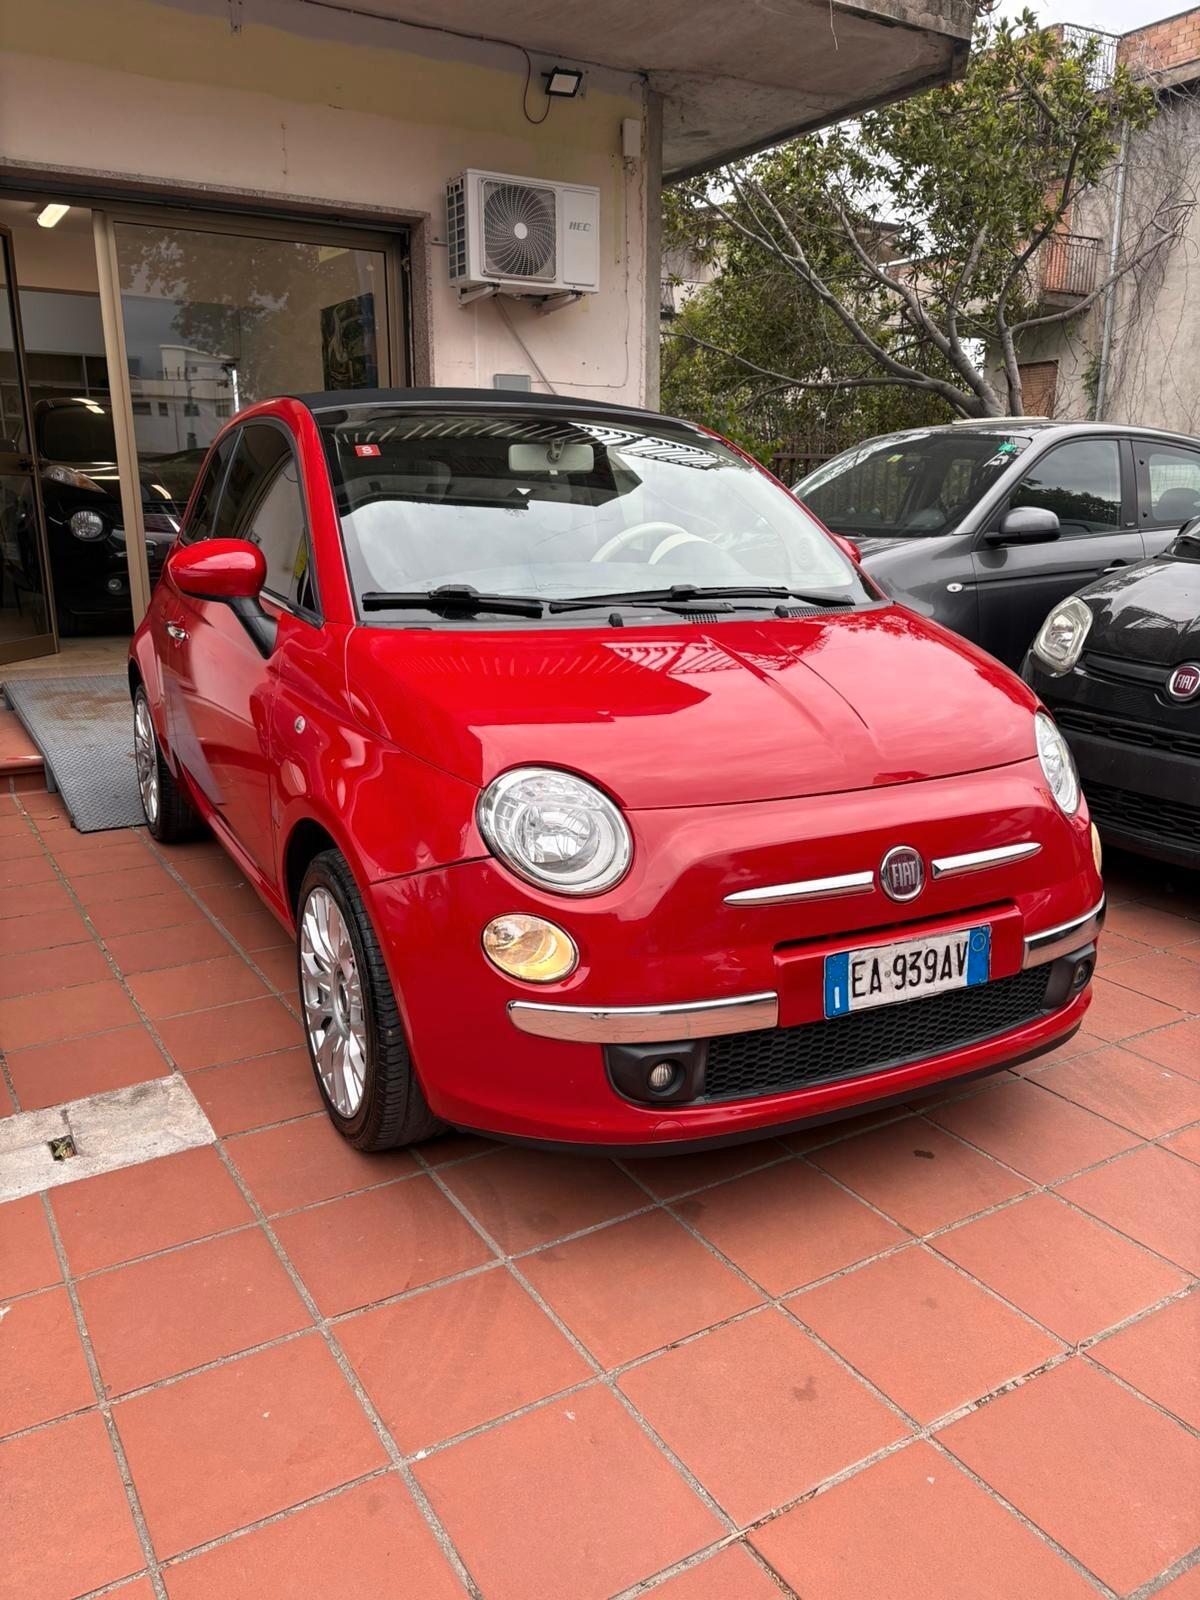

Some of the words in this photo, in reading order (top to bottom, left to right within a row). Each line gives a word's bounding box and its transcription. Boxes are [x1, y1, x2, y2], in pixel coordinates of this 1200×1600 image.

[1174, 674, 1196, 690] FIAT
[891, 861, 916, 887] FIAT
[851, 958, 882, 998] EA
[893, 941, 969, 991] 939AV
